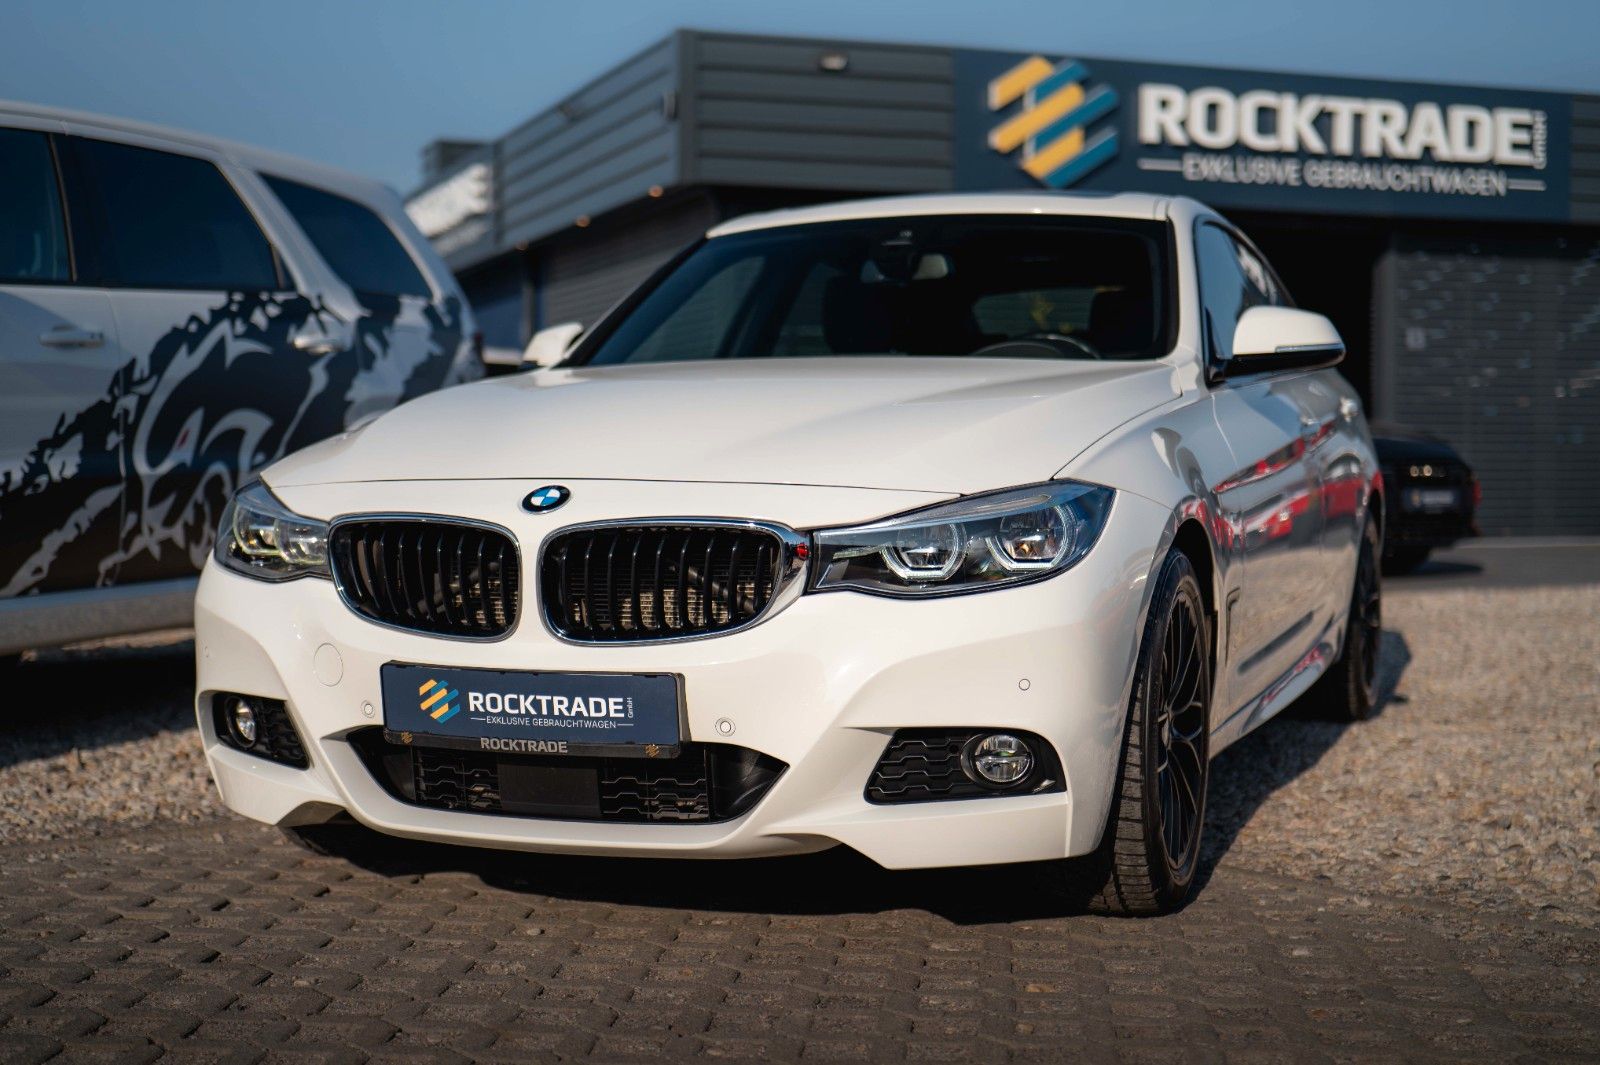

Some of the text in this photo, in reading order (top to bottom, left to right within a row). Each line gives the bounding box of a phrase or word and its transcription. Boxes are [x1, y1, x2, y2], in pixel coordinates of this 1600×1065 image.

[1138, 82, 1534, 167] ROCKTRADE
[1182, 152, 1507, 196] EXKLUSIVE GEBRAUCHTWAGEN
[468, 691, 625, 718] ROCKTRADE
[486, 715, 617, 729] EXKLUSIVE GEBRAUCHTWAGEN
[480, 737, 568, 753] ROCKTRADE
